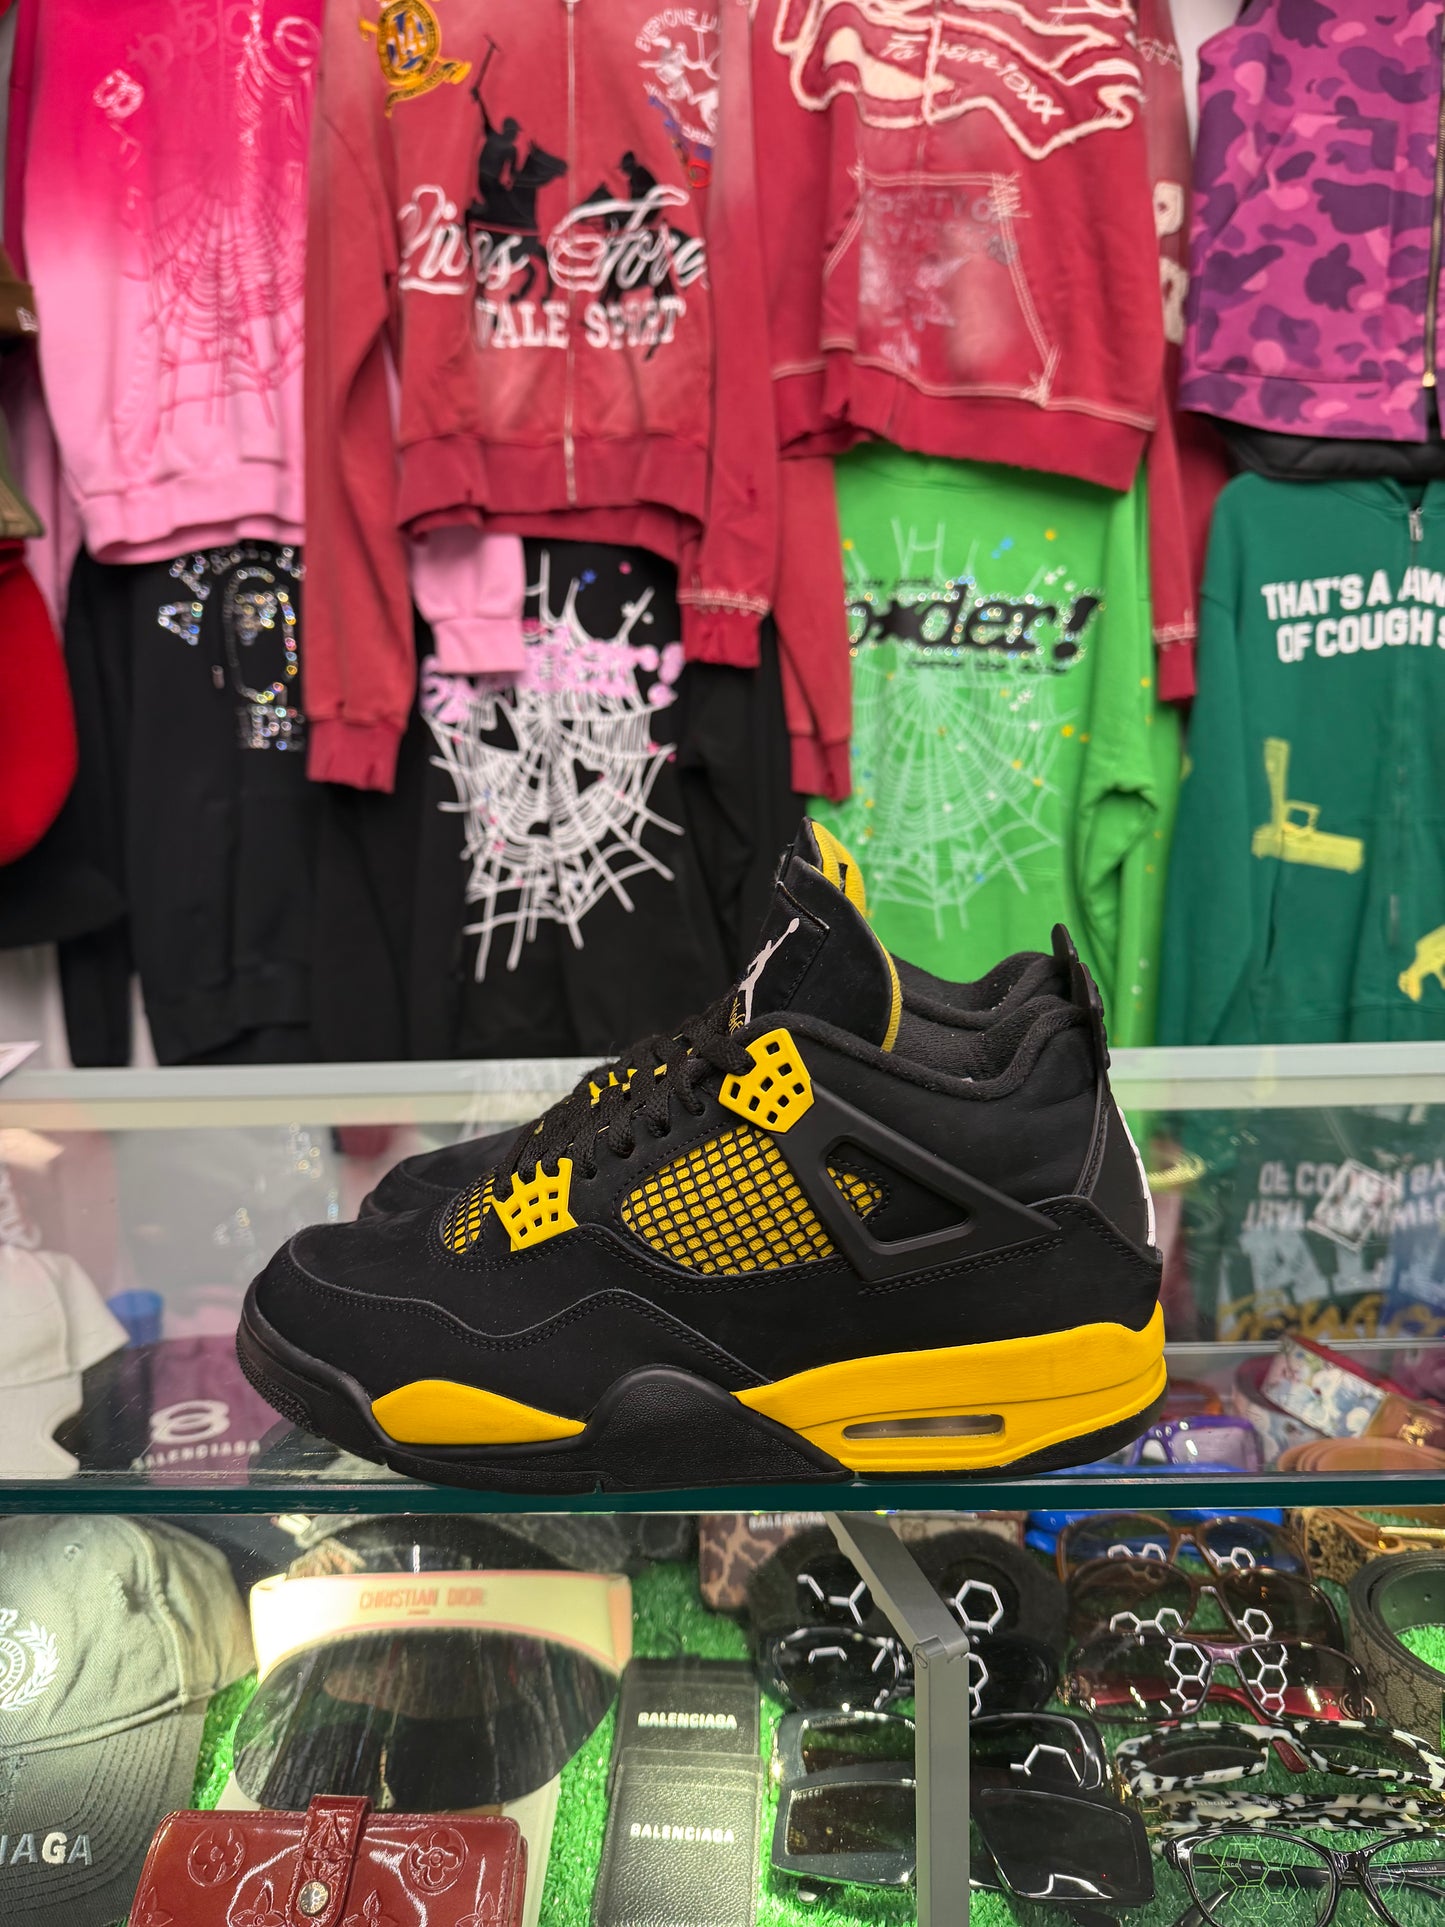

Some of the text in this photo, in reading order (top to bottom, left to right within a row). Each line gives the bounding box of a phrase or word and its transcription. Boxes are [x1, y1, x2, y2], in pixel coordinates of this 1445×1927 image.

[1260, 573, 1364, 621] THAT'S
[1366, 569, 1392, 606] A
[1276, 621, 1313, 663] OF
[1315, 605, 1436, 658] COUGH
[360, 1586, 484, 1609] CHRISTIAN DIOR
[638, 1711, 737, 1730] BALENCIAGA
[798, 1789, 823, 1799] GUCCI
[630, 1822, 735, 1843] BALENCIAGA
